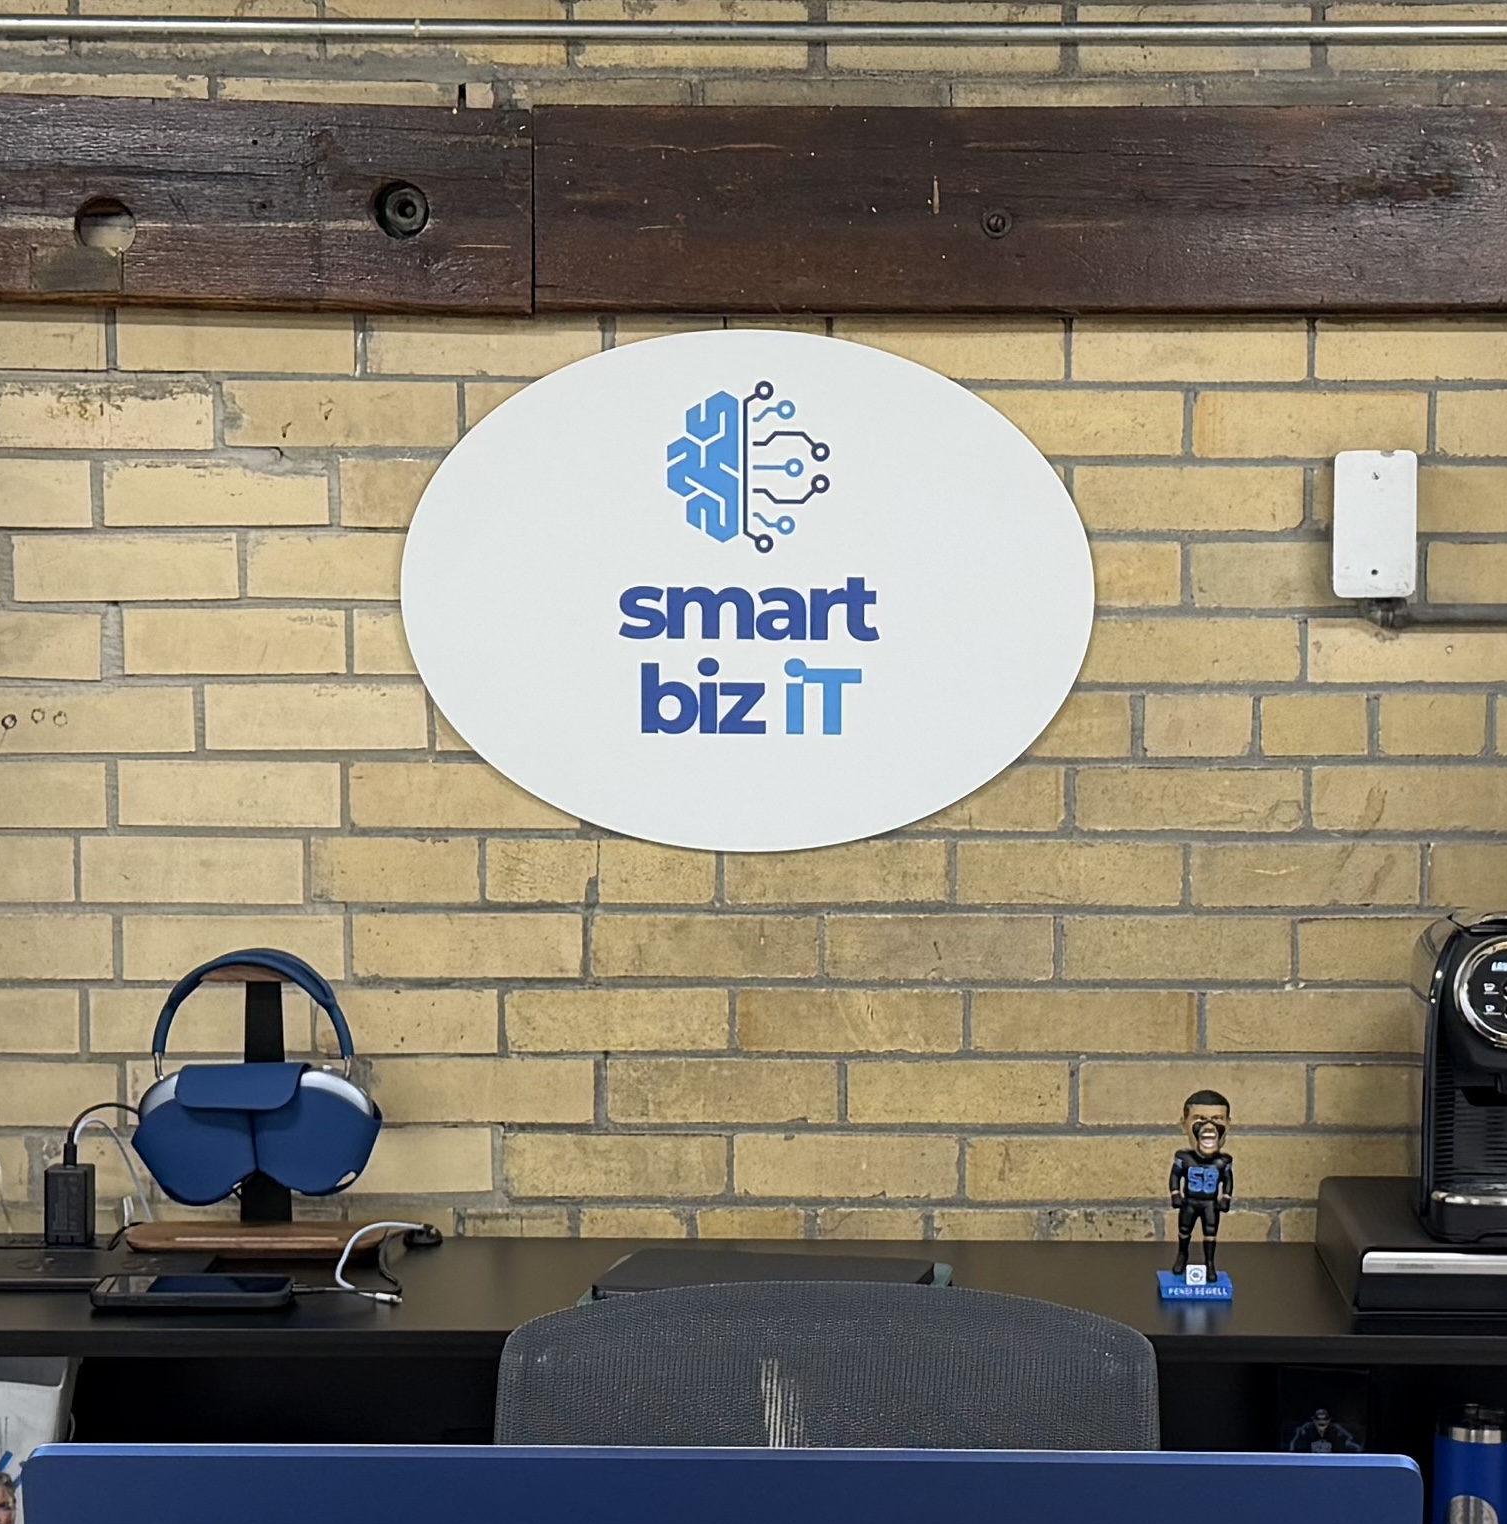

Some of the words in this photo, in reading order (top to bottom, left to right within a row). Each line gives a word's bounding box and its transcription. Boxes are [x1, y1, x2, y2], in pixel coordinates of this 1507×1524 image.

[618, 576, 880, 642] smart
[640, 657, 766, 735] biz
[784, 657, 862, 736] iT
[1187, 1166, 1220, 1194] 58
